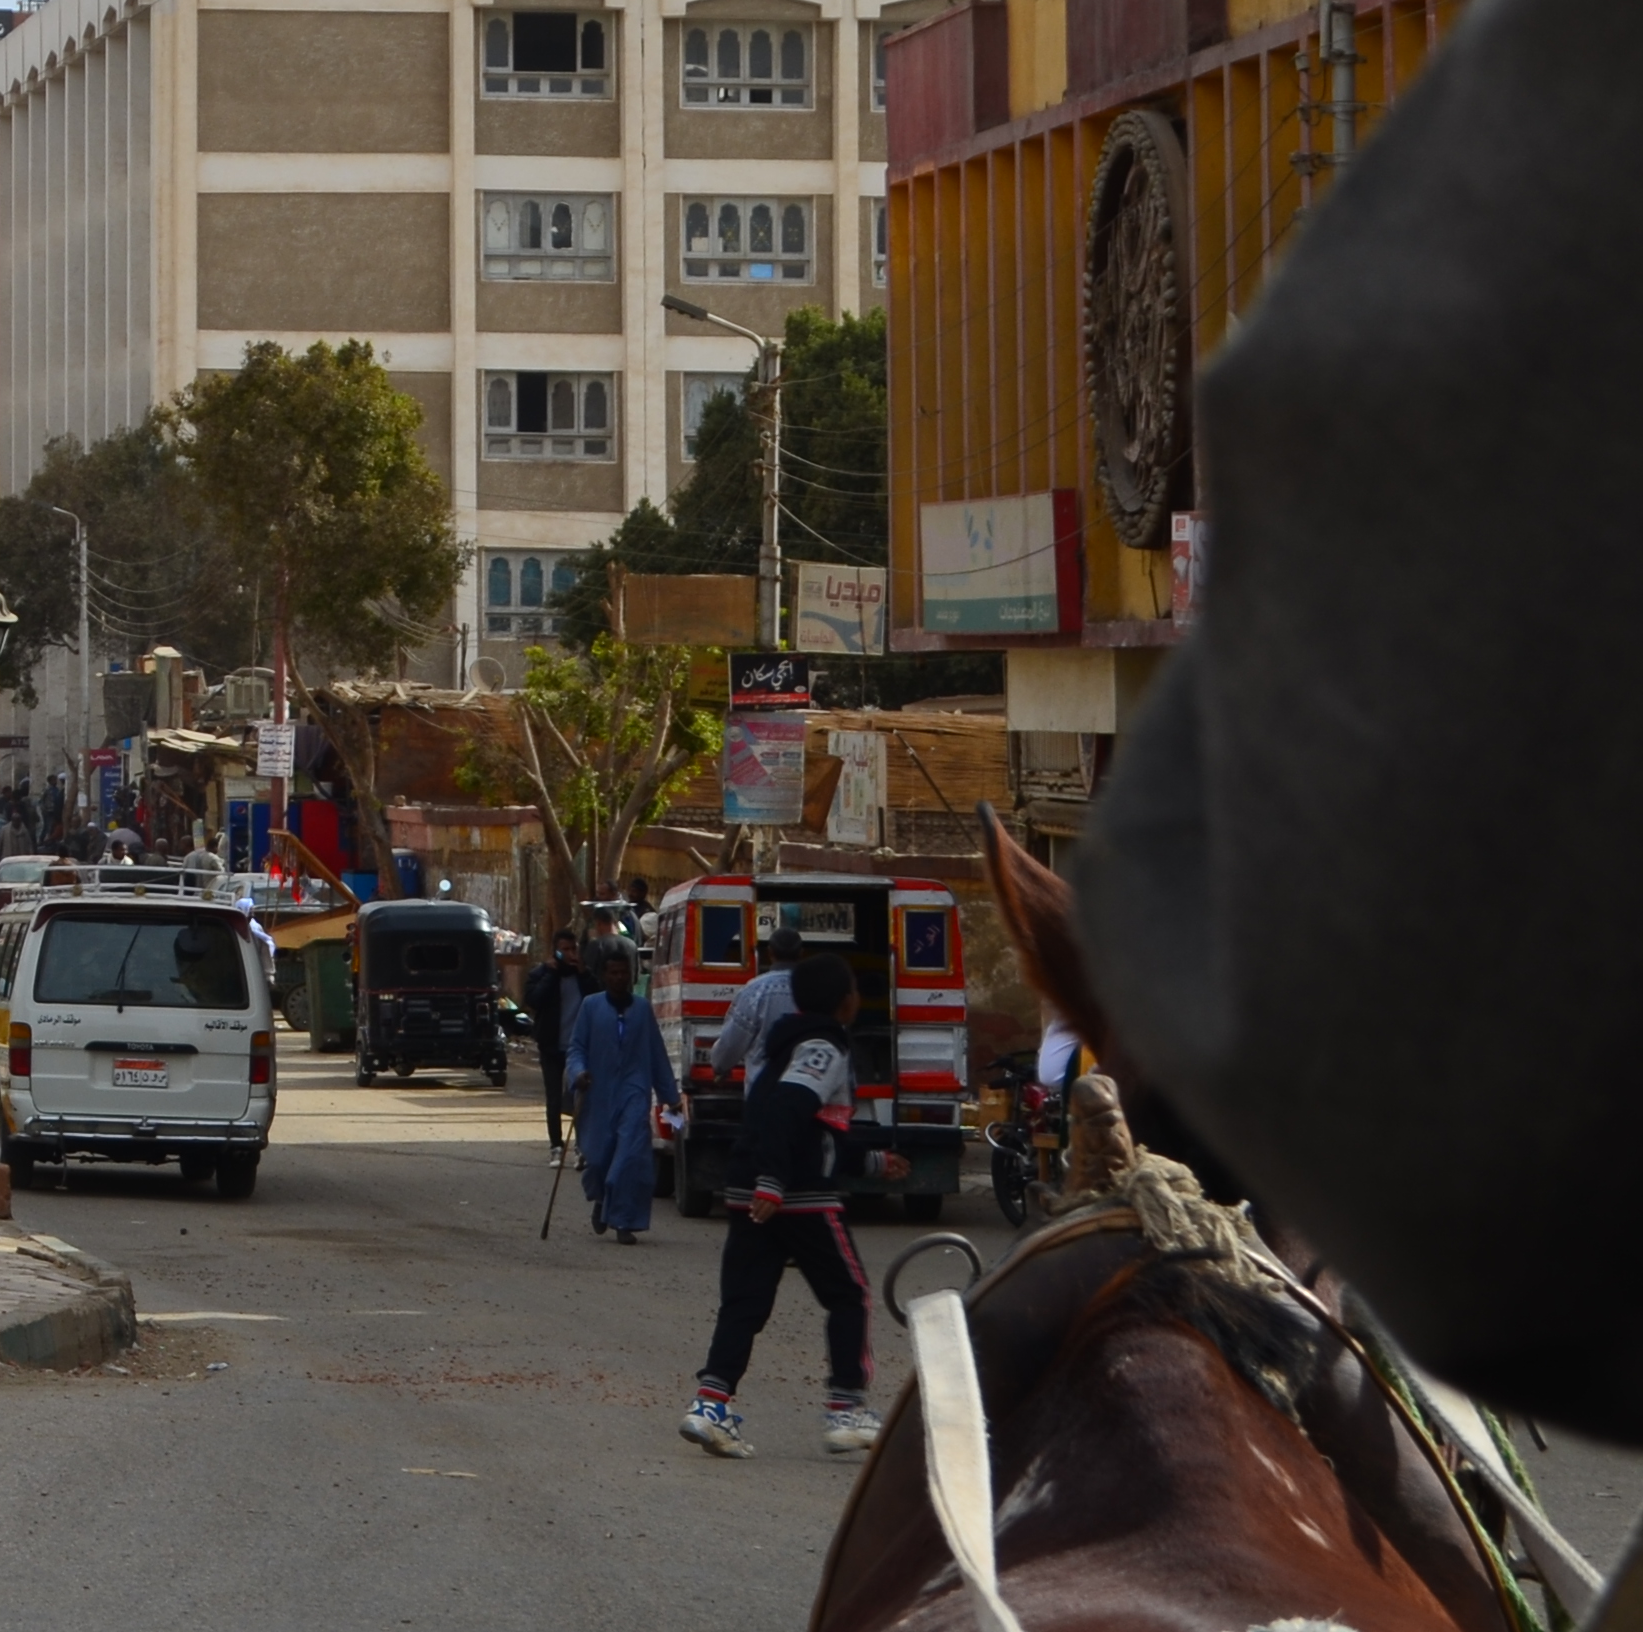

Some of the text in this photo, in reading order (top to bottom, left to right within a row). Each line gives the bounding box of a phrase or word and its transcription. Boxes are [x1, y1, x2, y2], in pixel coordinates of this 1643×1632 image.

[826, 575, 882, 609] ميديا
[62, 1015, 81, 1026] موقف
[229, 1021, 248, 1032] موقف
[127, 1043, 154, 1051] TOYOTA
